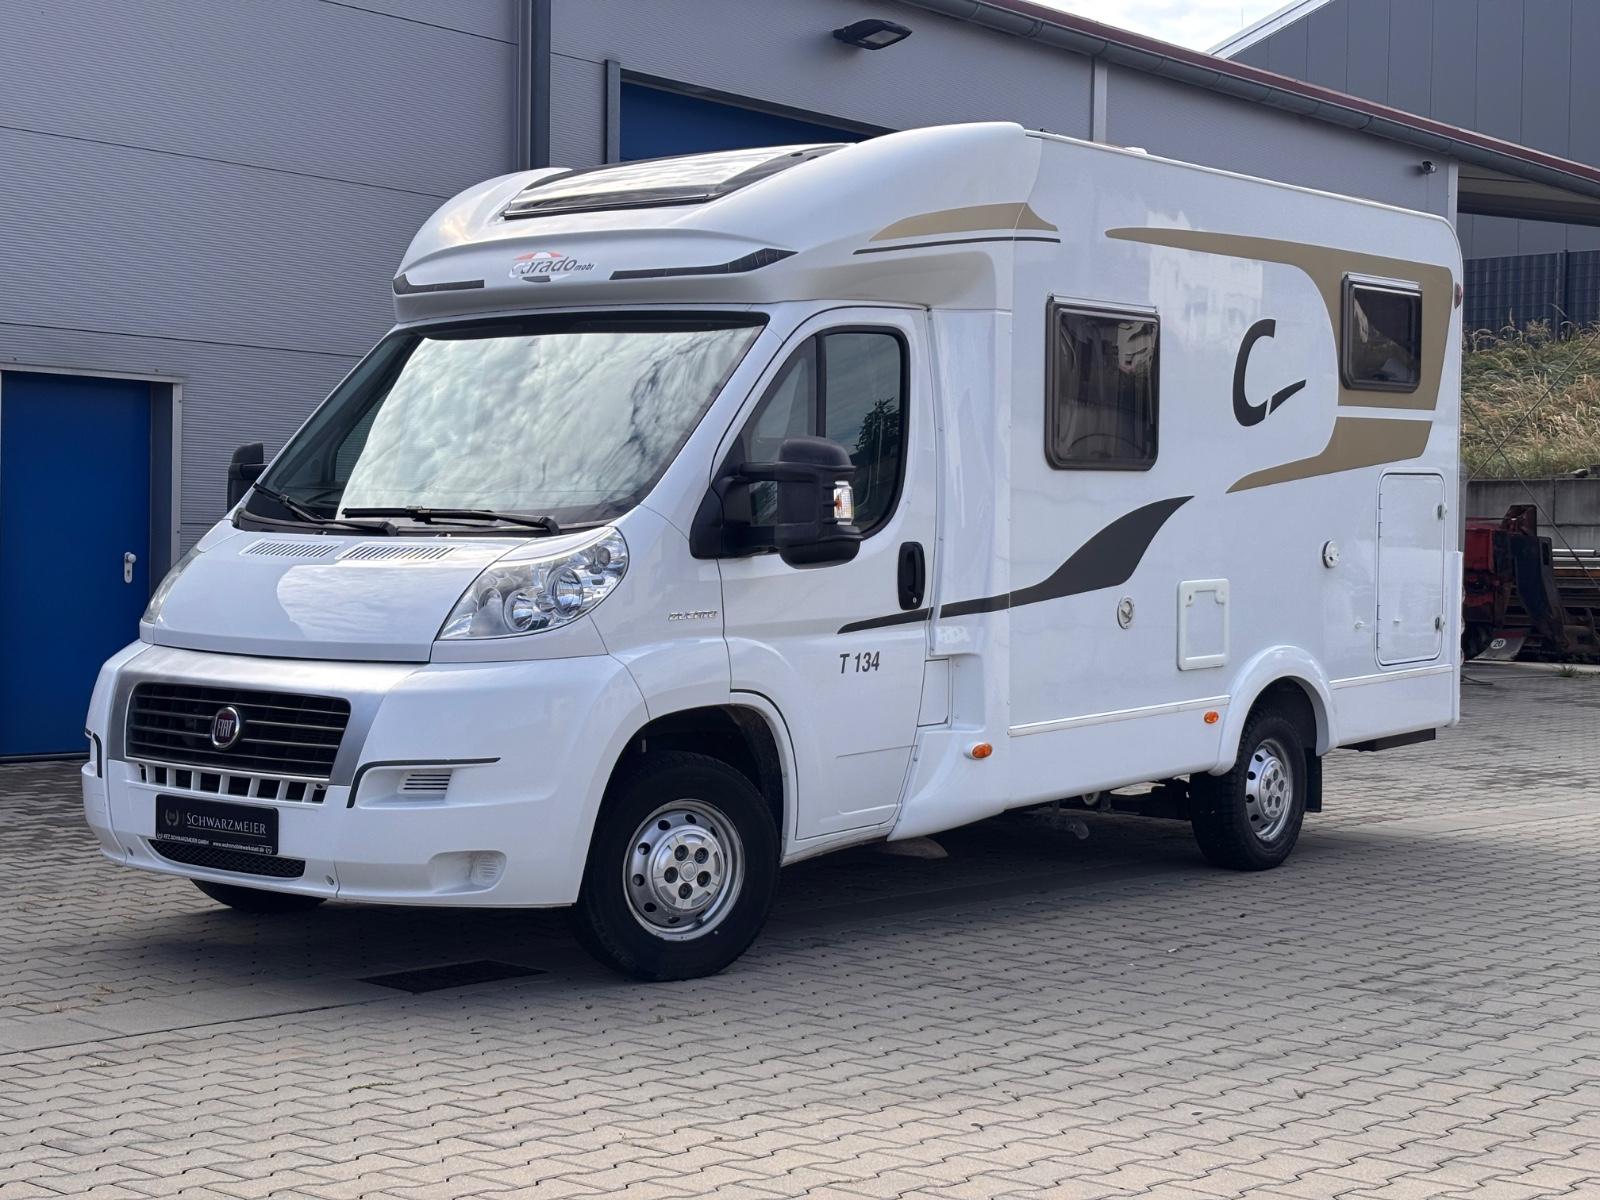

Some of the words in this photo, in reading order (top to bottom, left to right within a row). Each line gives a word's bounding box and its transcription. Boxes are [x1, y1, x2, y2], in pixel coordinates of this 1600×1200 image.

[840, 653, 850, 674] T
[855, 651, 880, 672] 134
[216, 718, 235, 737] FIAT
[186, 812, 267, 834] SCHWARZMEIER
